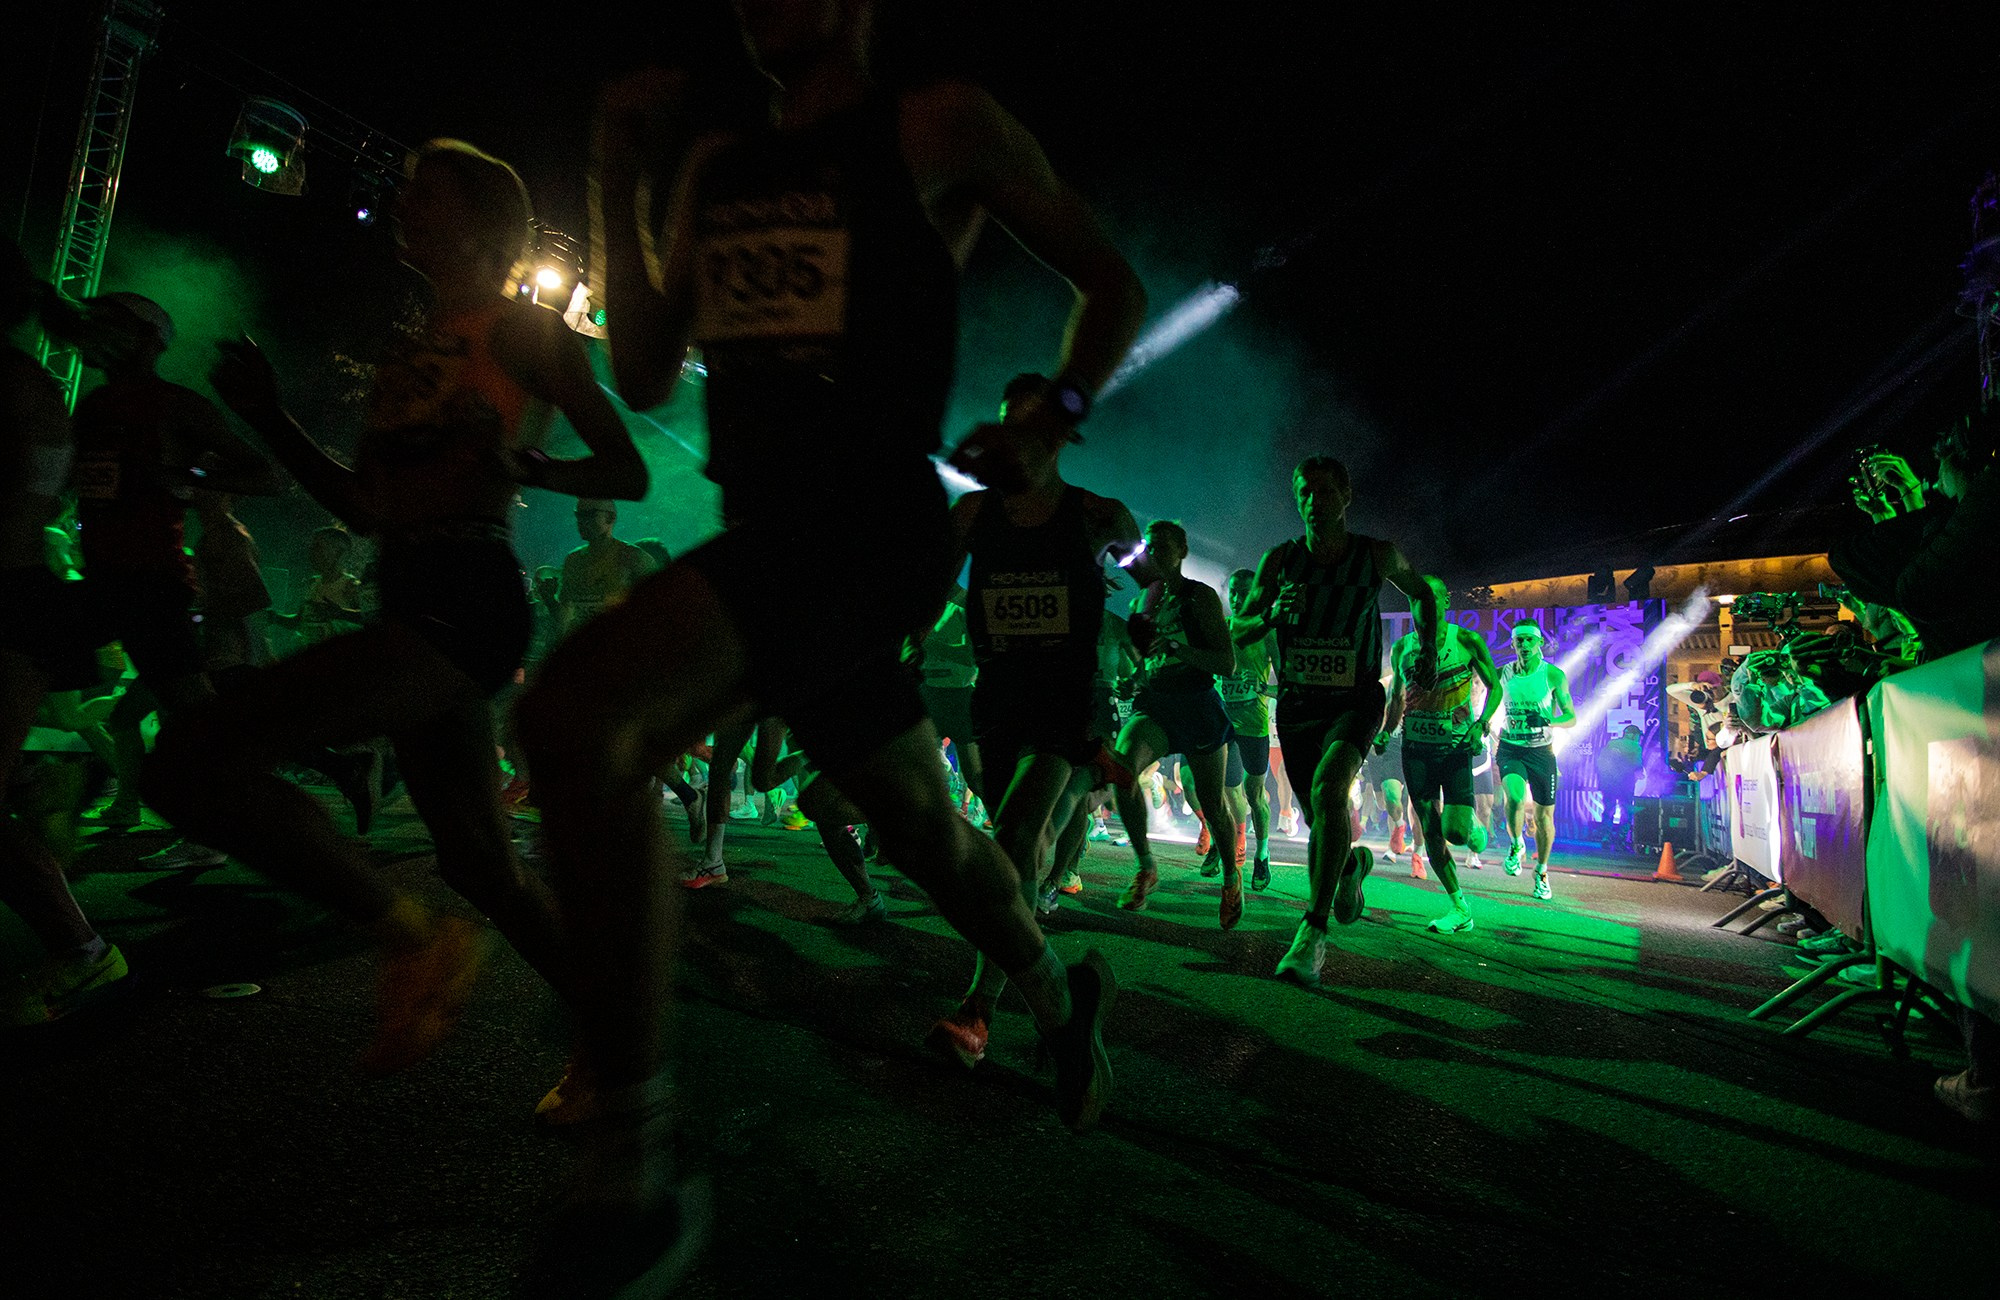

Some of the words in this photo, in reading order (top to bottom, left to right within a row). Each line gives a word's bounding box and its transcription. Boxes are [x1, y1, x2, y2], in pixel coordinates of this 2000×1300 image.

[994, 594, 1058, 620] 6508
[1293, 654, 1347, 674] 3988
[1222, 682, 1250, 695] 8749
[1411, 721, 1447, 737] 4656
